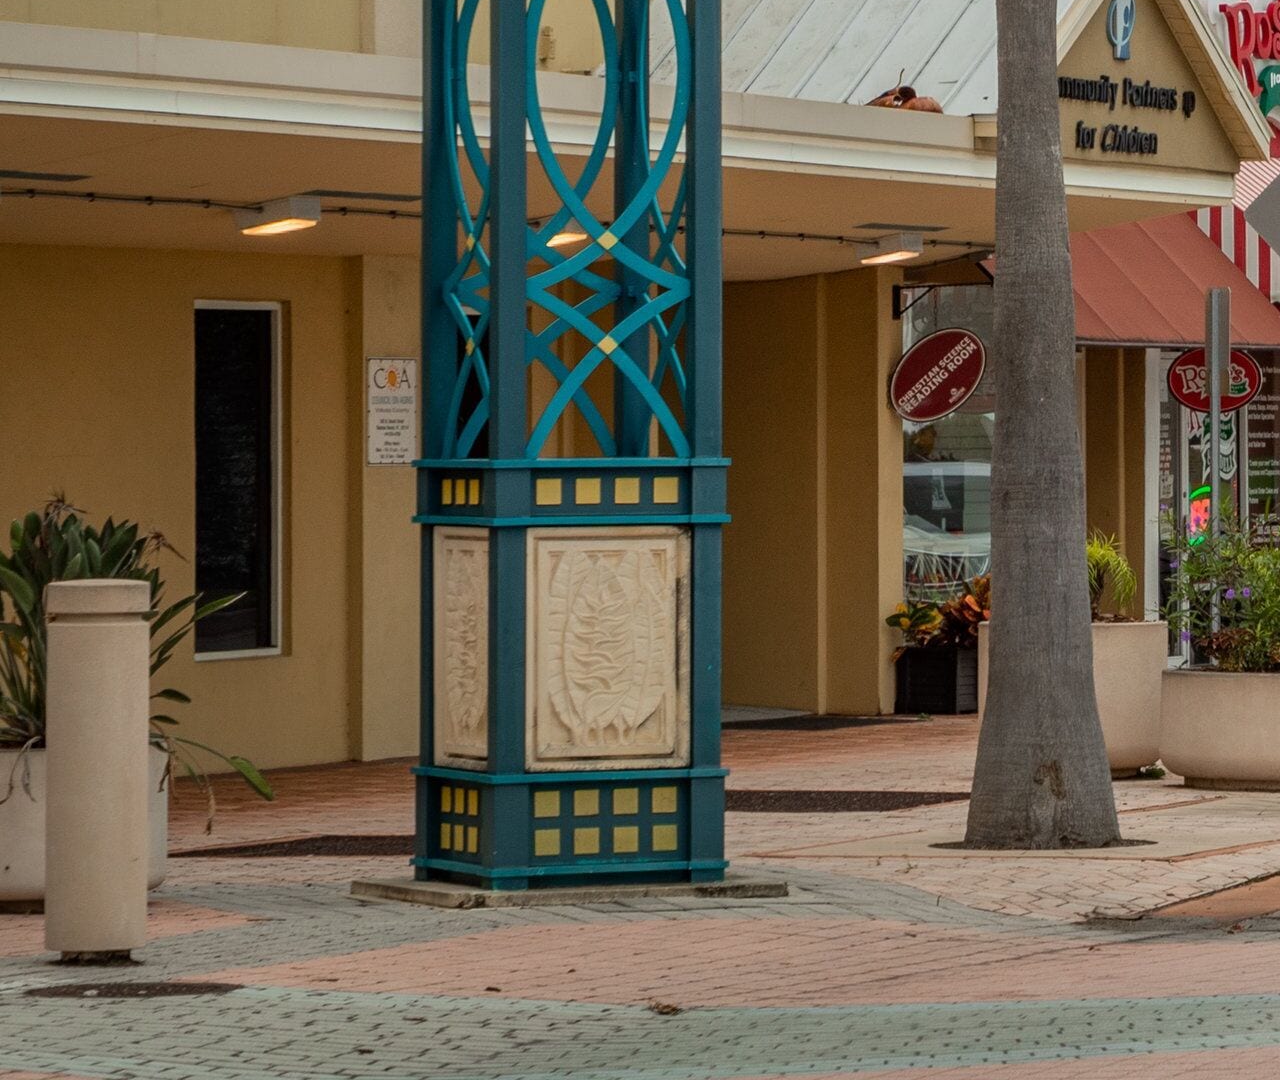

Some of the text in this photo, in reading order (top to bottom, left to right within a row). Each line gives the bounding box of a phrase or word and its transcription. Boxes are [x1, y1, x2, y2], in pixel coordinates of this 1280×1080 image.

[1075, 120, 1158, 155] for Children
[898, 365, 941, 407] CHRISTIAN
[938, 336, 972, 368] SCIENCE
[903, 369, 949, 413] READING
[946, 342, 978, 372] ROOM
